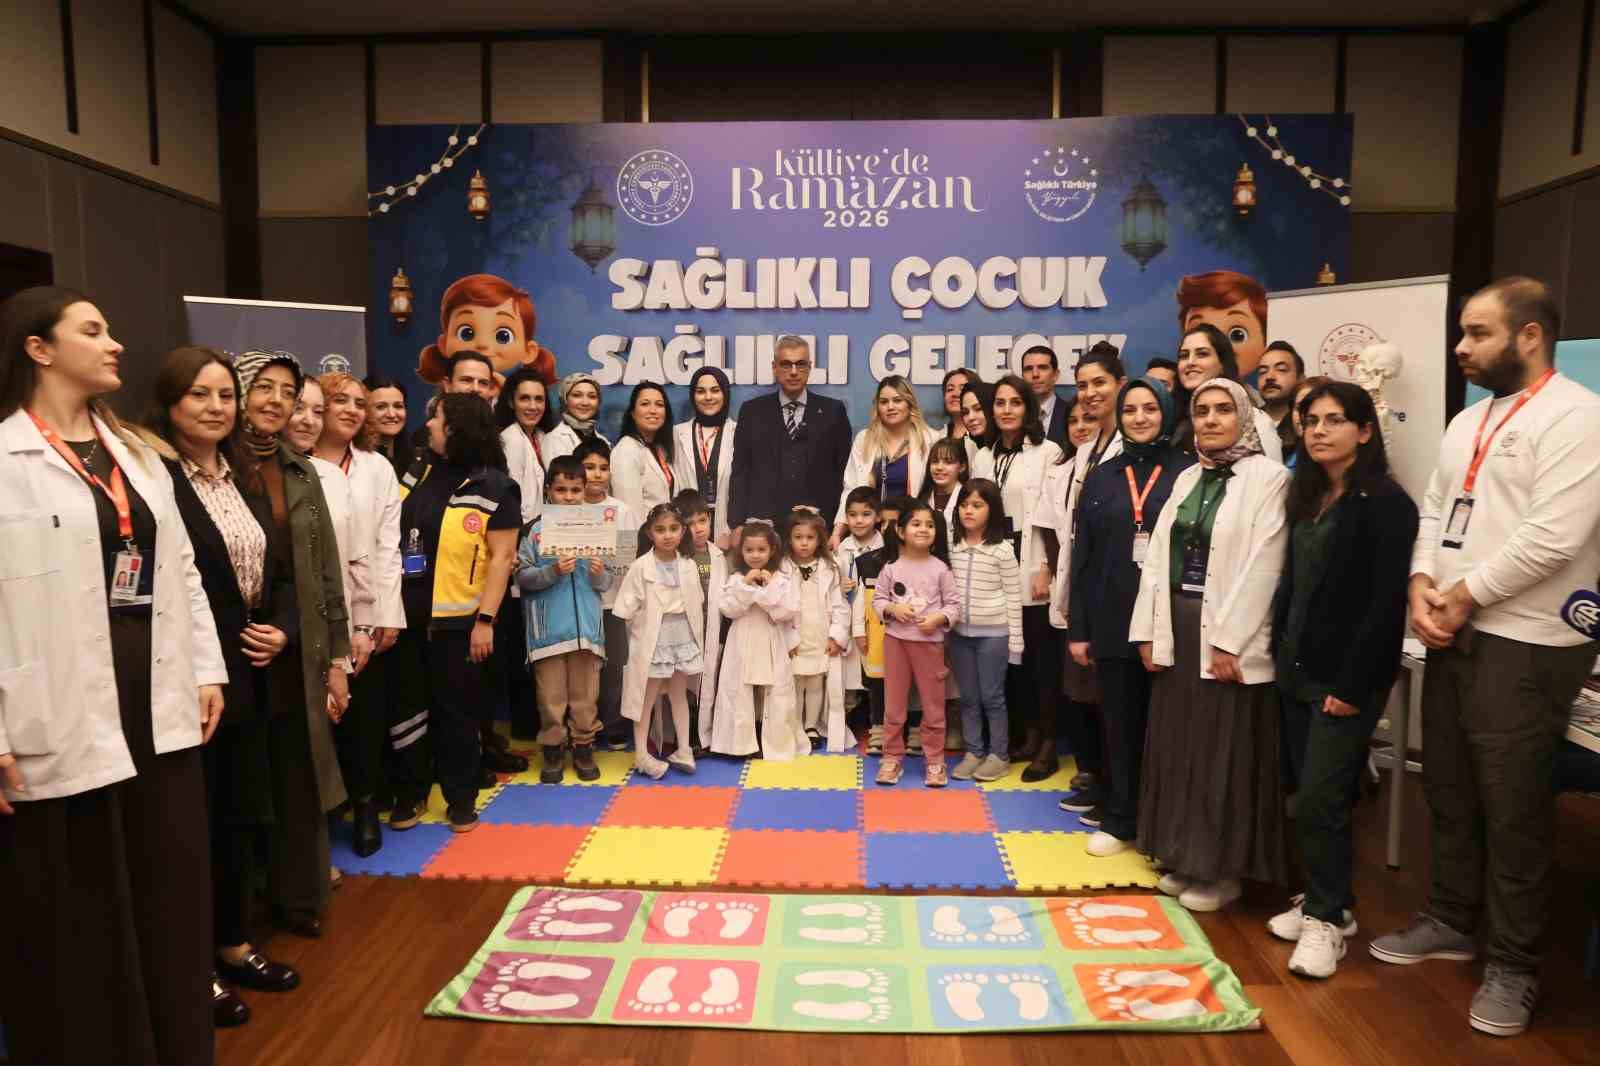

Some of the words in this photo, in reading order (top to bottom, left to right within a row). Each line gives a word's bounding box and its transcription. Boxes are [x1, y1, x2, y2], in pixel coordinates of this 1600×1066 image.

[731, 167, 984, 212] Ramazan
[823, 210, 890, 228] 2026
[608, 246, 872, 311] SAĞLIKLI
[890, 256, 1108, 319] ÇOCUK
